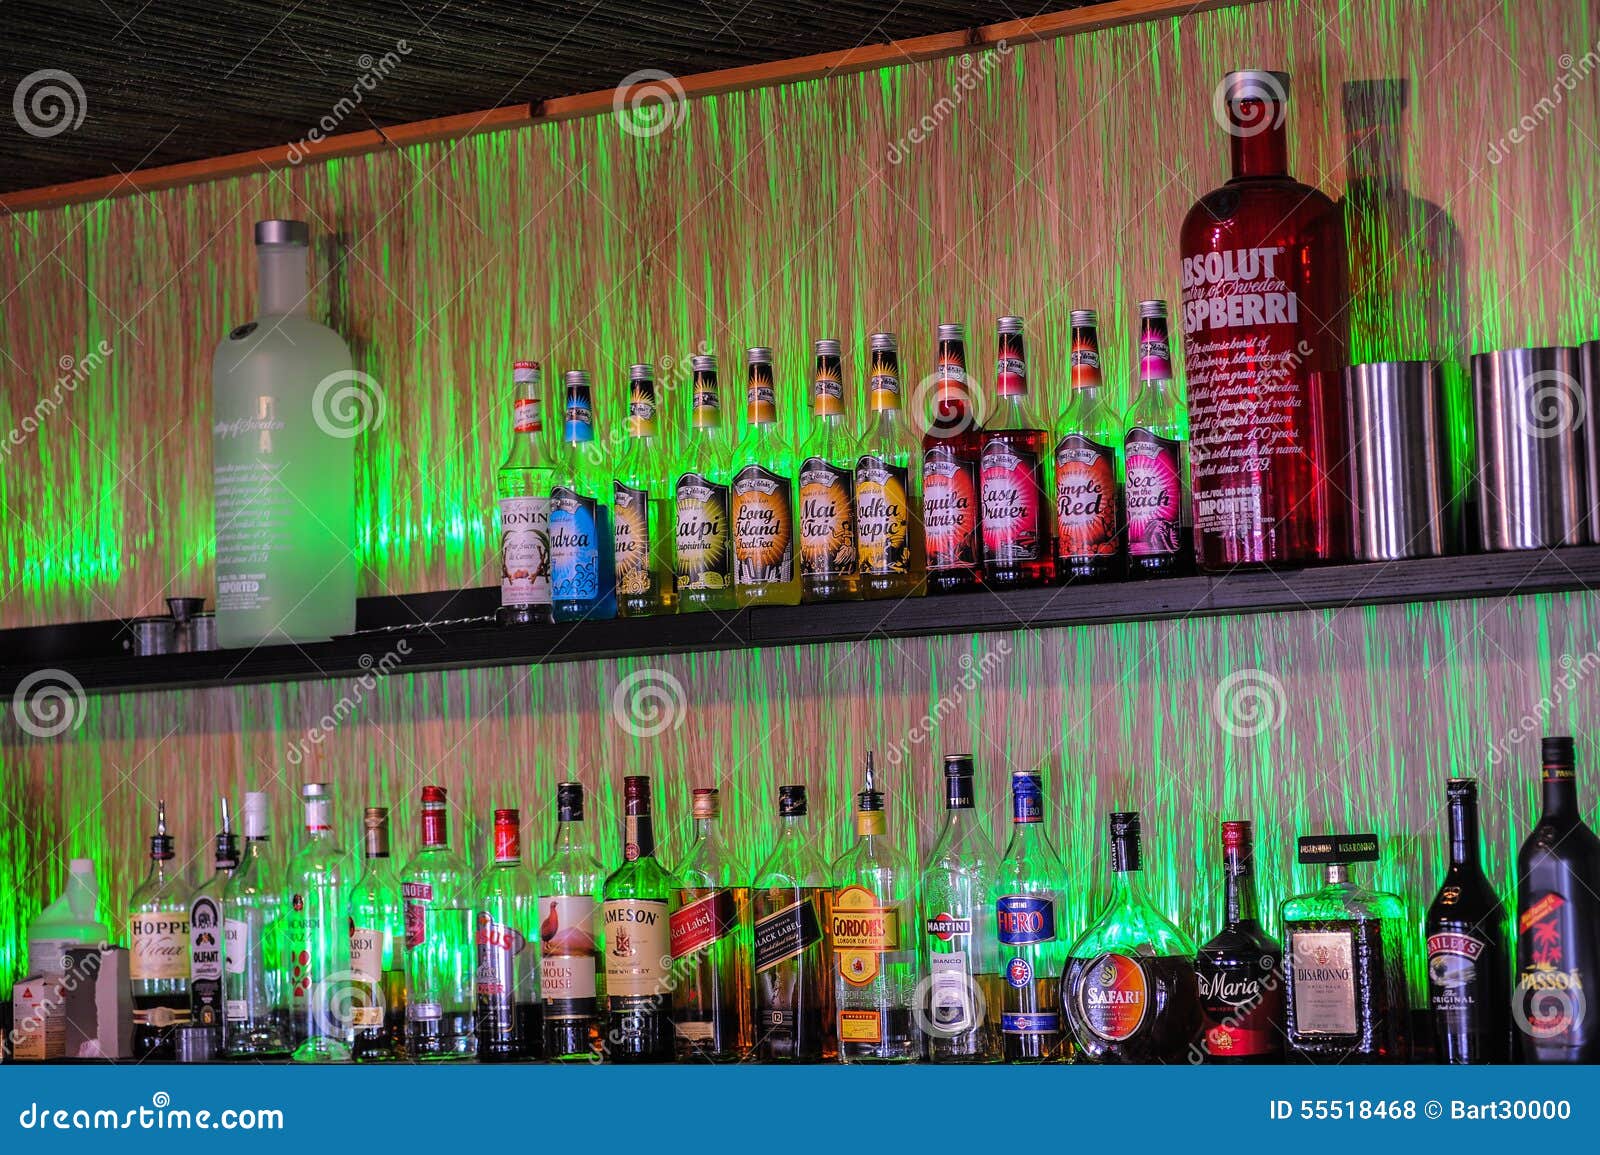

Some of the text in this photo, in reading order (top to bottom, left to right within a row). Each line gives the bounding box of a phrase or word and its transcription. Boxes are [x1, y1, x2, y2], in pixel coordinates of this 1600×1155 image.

[1181, 246, 1278, 289] BSOLUT
[1207, 278, 1224, 299] of
[1222, 275, 1286, 300] Sweden
[1184, 291, 1298, 334] SPBERRI
[1244, 426, 1272, 441] 400
[1127, 470, 1158, 489] Sex
[737, 504, 775, 524] Long
[801, 498, 837, 519] Mai
[1058, 494, 1103, 517] Red
[735, 519, 781, 537] Island
[133, 919, 190, 935] HOPPE
[605, 908, 657, 927] AMESON
[927, 921, 969, 932] MARTINI
[997, 910, 1045, 934] FIERO
[777, 920, 802, 938] LABEL
[1430, 935, 1480, 954] AILEYS
[1299, 968, 1350, 982] DISARONNO
[1208, 972, 1260, 1000] Maria
[1087, 987, 1141, 1005] SAFARI
